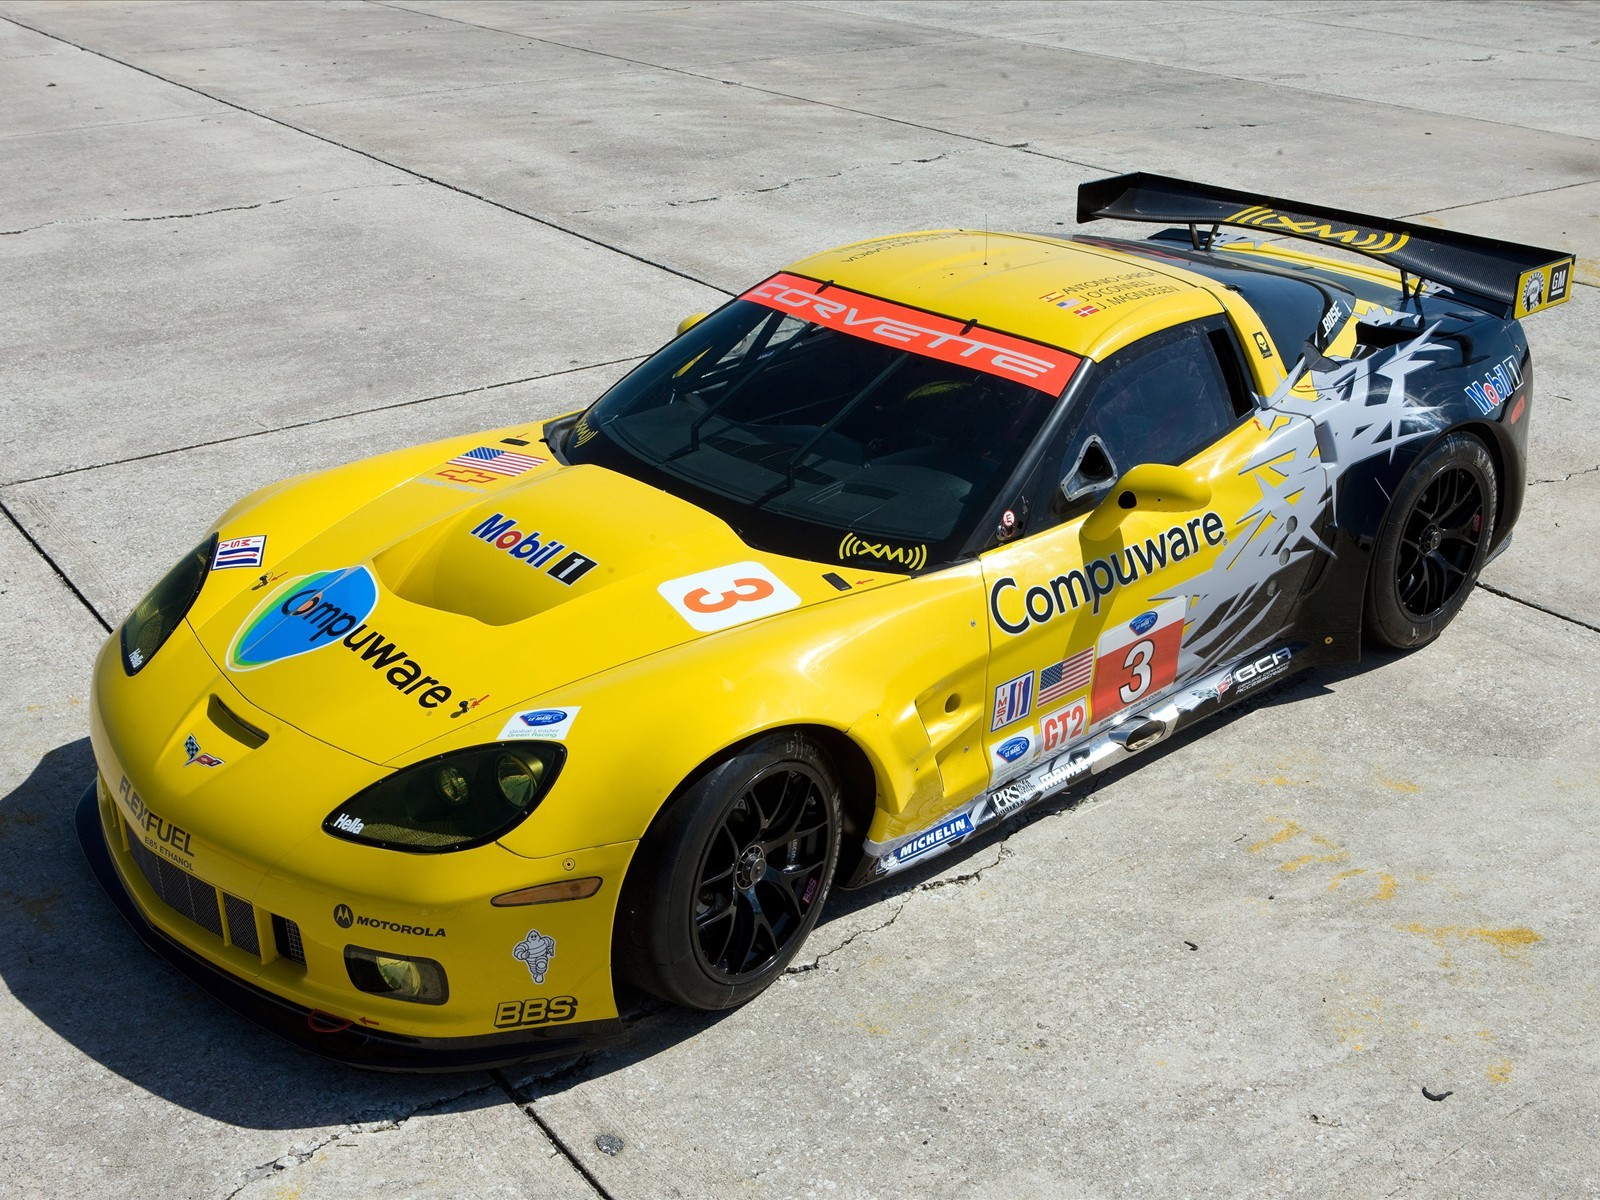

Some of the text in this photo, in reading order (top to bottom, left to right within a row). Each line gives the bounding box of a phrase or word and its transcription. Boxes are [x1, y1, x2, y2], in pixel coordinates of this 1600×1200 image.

[1062, 276, 1119, 294] ANTONIO
[1106, 285, 1180, 306] MAGNUSSEN
[1552, 270, 1567, 290] GM
[752, 282, 1056, 378] CORVETTE
[1322, 300, 1343, 338] BOSE
[1464, 364, 1514, 415] Mobil
[470, 512, 565, 568] Mobil
[990, 511, 1226, 635] Compuware
[683, 577, 775, 613] 3
[281, 589, 452, 708] Compuware
[1235, 647, 1292, 682] GCA
[1119, 639, 1155, 704] 3
[1043, 705, 1085, 752] GT2
[992, 784, 1021, 809] PRS
[119, 775, 195, 858] FLEXFUEL
[333, 813, 365, 835] Hella
[144, 836, 194, 871] E85 ETHANOL
[900, 818, 966, 858] MICHELIN
[356, 915, 447, 938] MOTOROLA
[494, 996, 578, 1029] BBS
